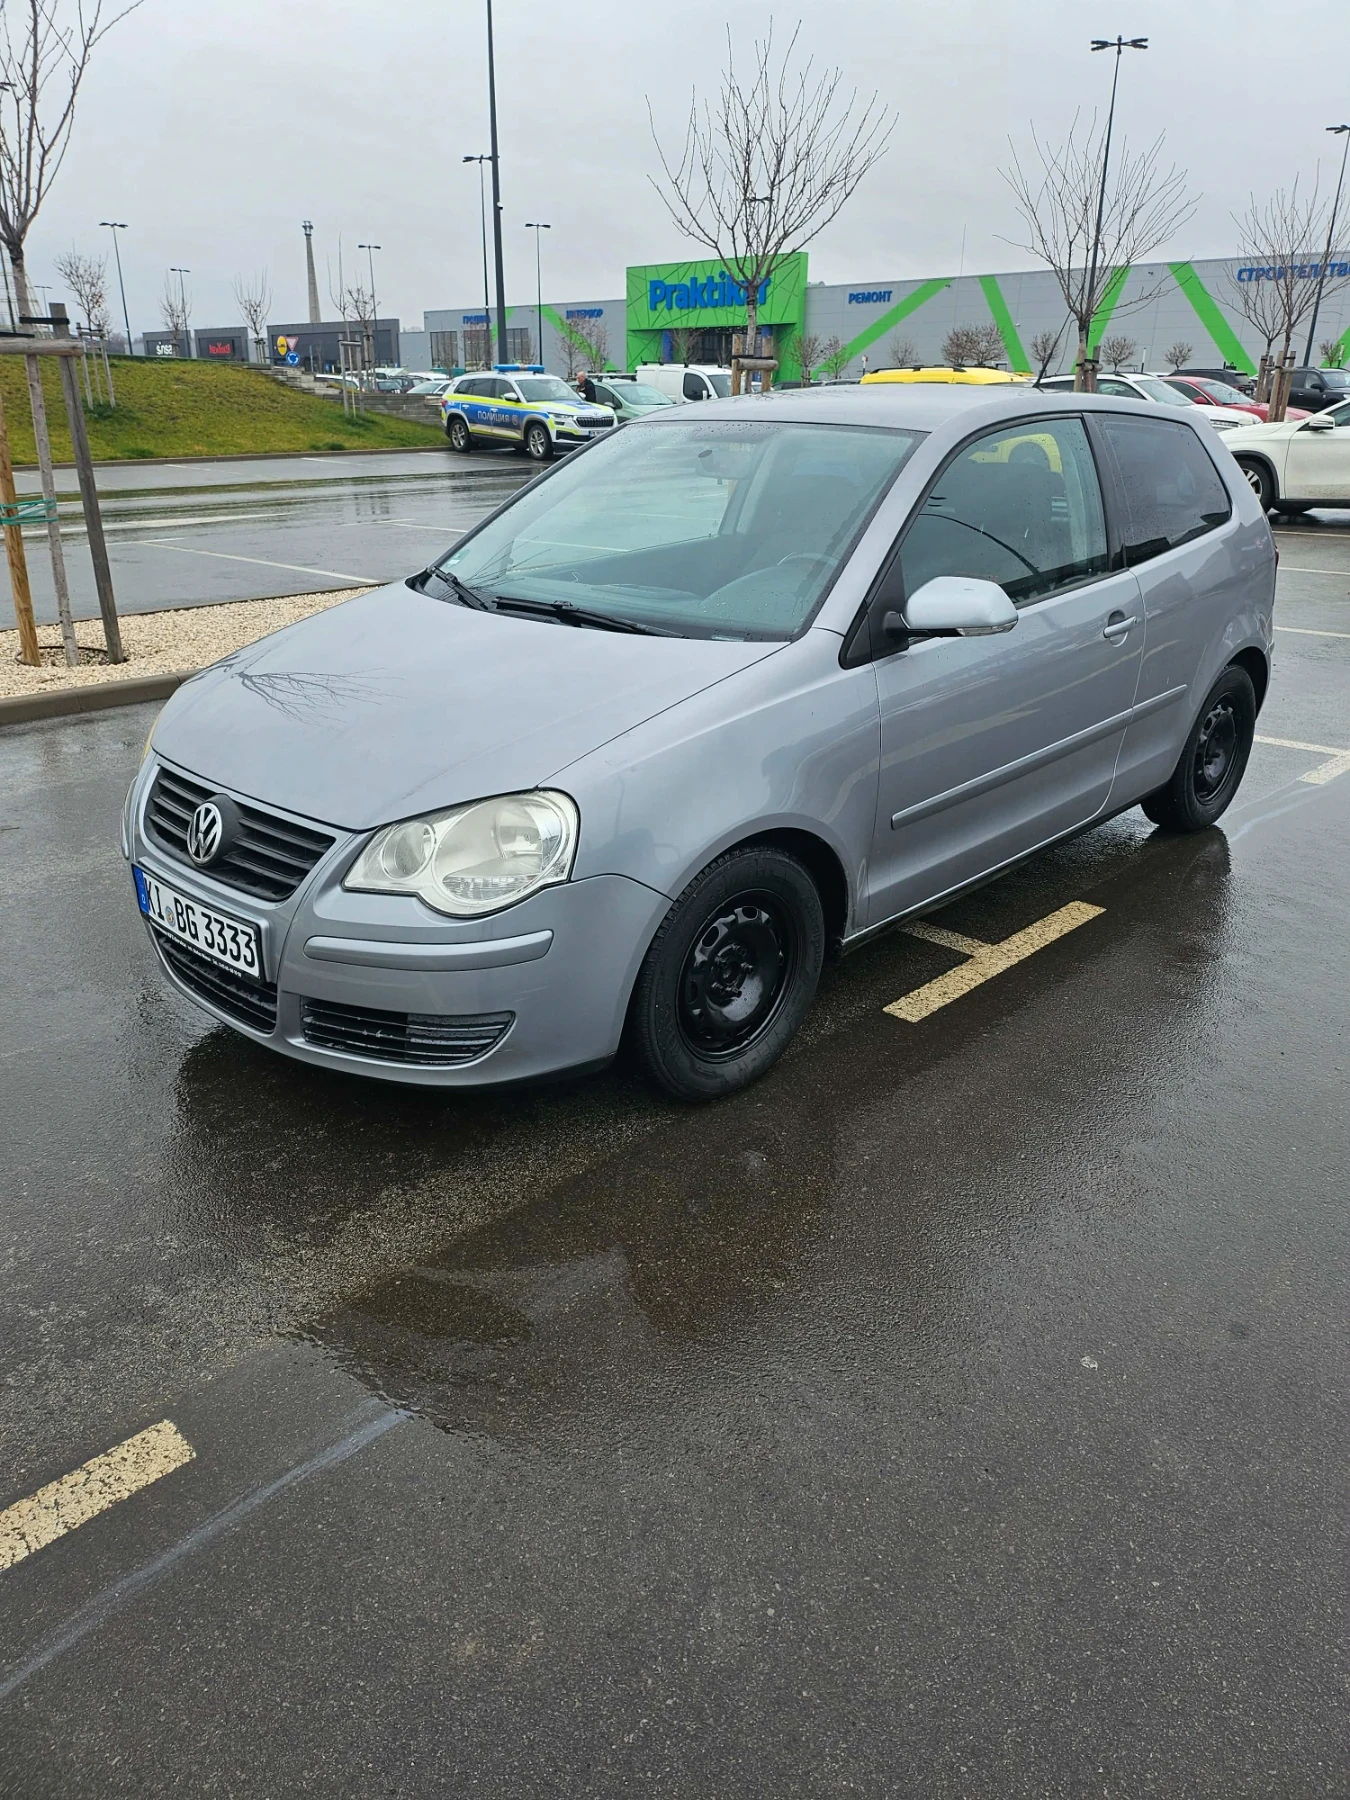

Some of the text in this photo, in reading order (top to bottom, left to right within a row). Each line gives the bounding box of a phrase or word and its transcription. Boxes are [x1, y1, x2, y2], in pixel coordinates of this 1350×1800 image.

[848, 290, 893, 304] РЕМОНТ
[477, 410, 510, 423] ПОЛИЦИЯ
[173, 896, 200, 942] BG
[201, 911, 256, 968] 3333
